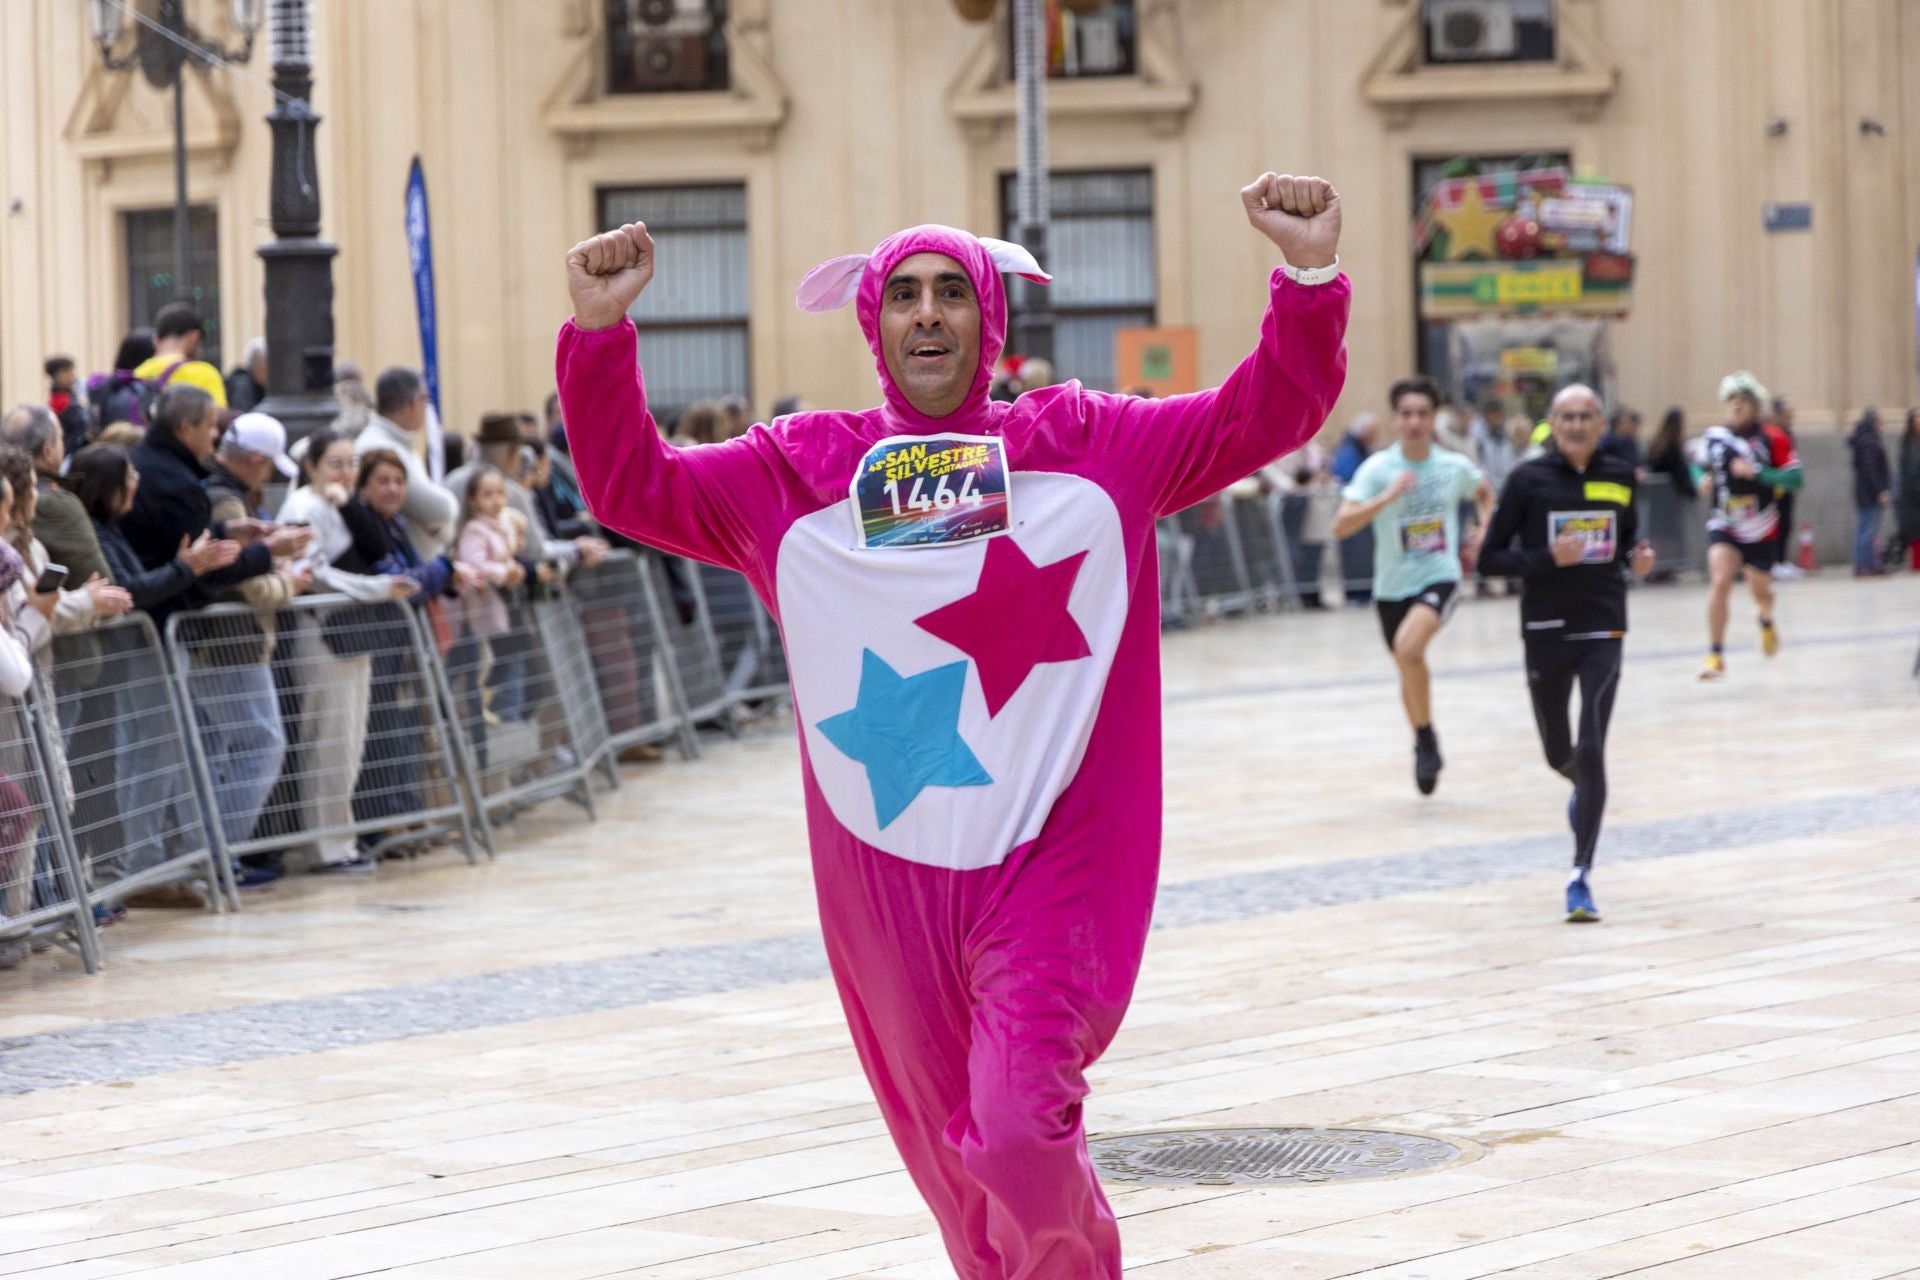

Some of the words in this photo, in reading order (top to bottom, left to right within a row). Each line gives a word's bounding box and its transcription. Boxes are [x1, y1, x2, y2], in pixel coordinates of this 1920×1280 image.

[885, 444, 926, 468] SAN
[885, 445, 988, 481] SILVESTRE
[930, 456, 990, 477] CARTAGENA
[883, 471, 983, 515] 1464
